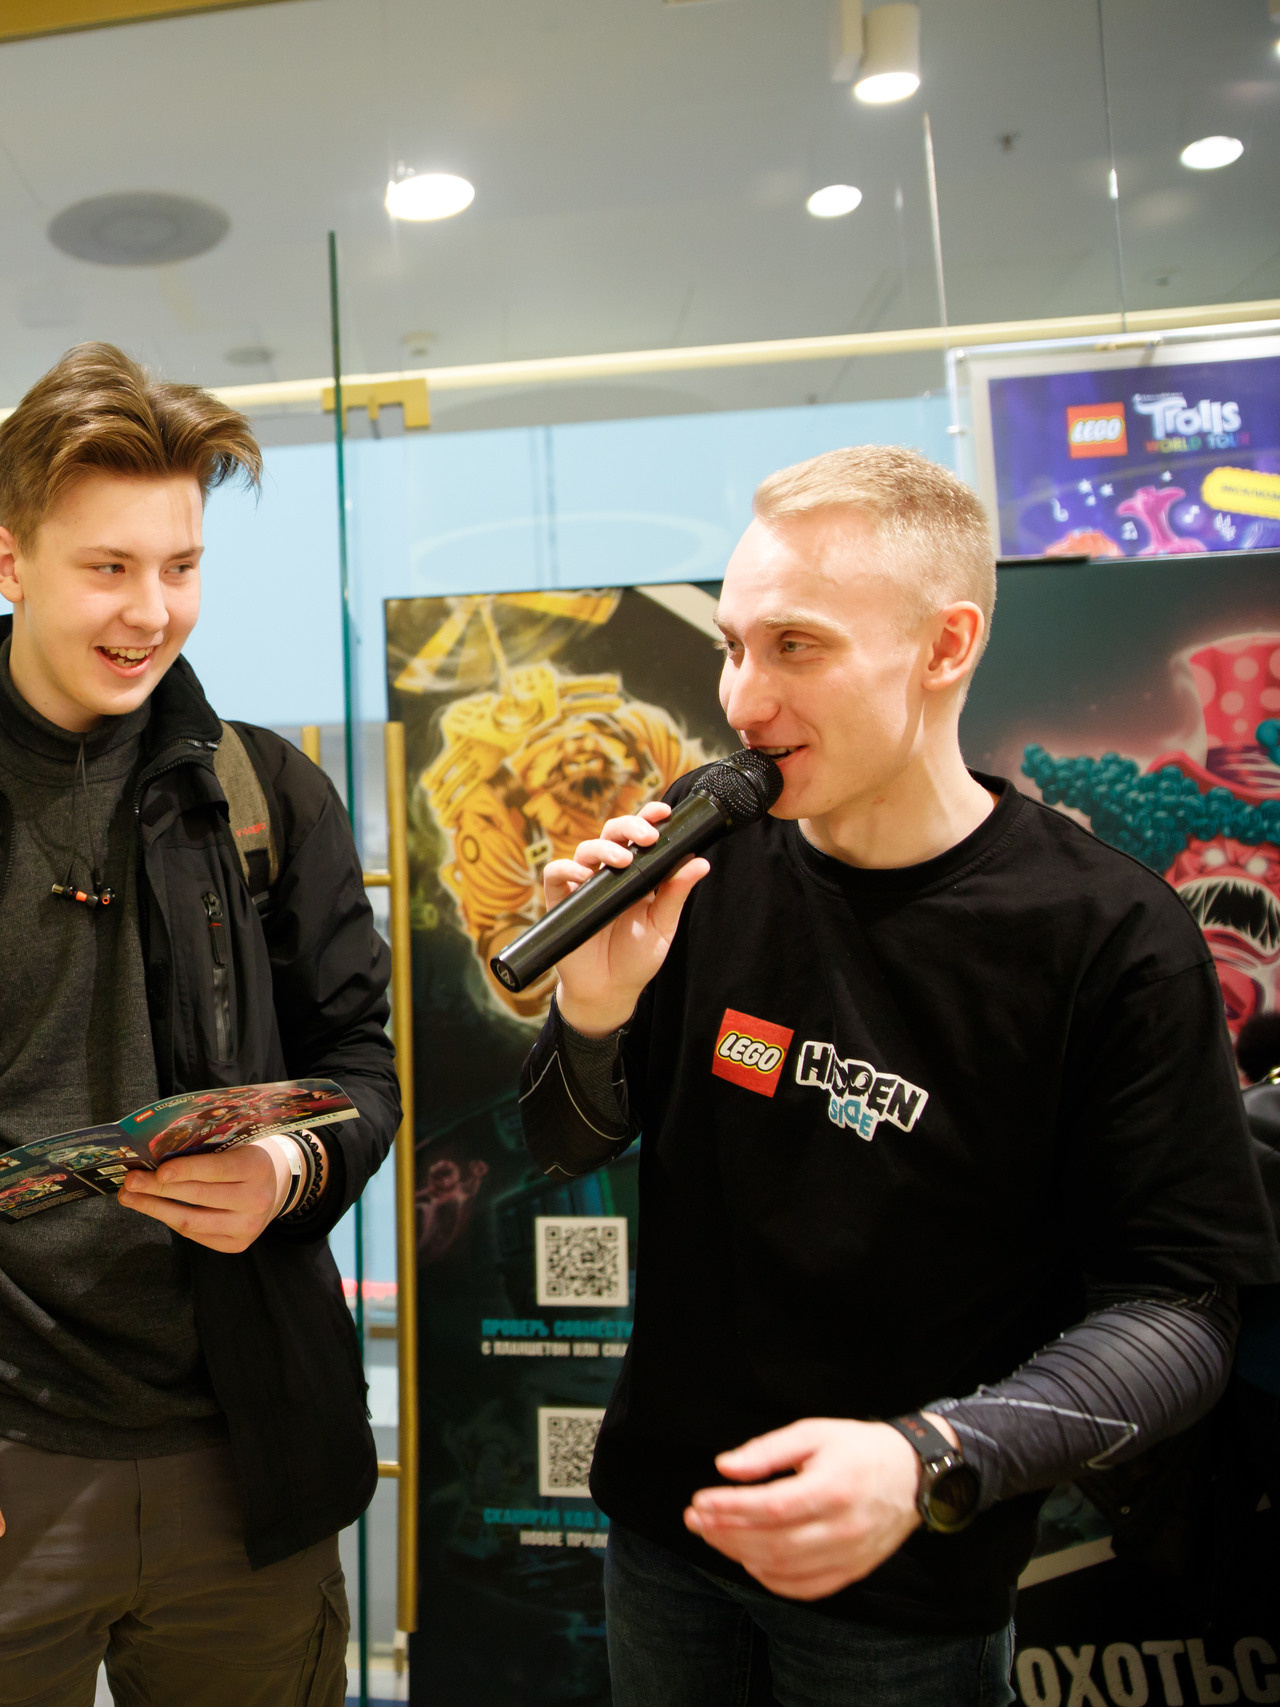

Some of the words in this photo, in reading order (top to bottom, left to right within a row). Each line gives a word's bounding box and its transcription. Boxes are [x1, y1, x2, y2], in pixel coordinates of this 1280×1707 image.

[1070, 416, 1124, 445] LEGO
[1132, 395, 1242, 440] Trolls
[1145, 435, 1203, 453] WORLD
[718, 1032, 783, 1073] LEGO
[798, 1043, 926, 1130] HIDDEN
[829, 1098, 874, 1137] SIDE
[481, 1318, 550, 1337] ПРОВЕРЬ
[481, 1341, 491, 1356] С
[572, 1342, 600, 1357] ИЛИ
[1016, 1636, 1280, 1707] ОХОТЬС
